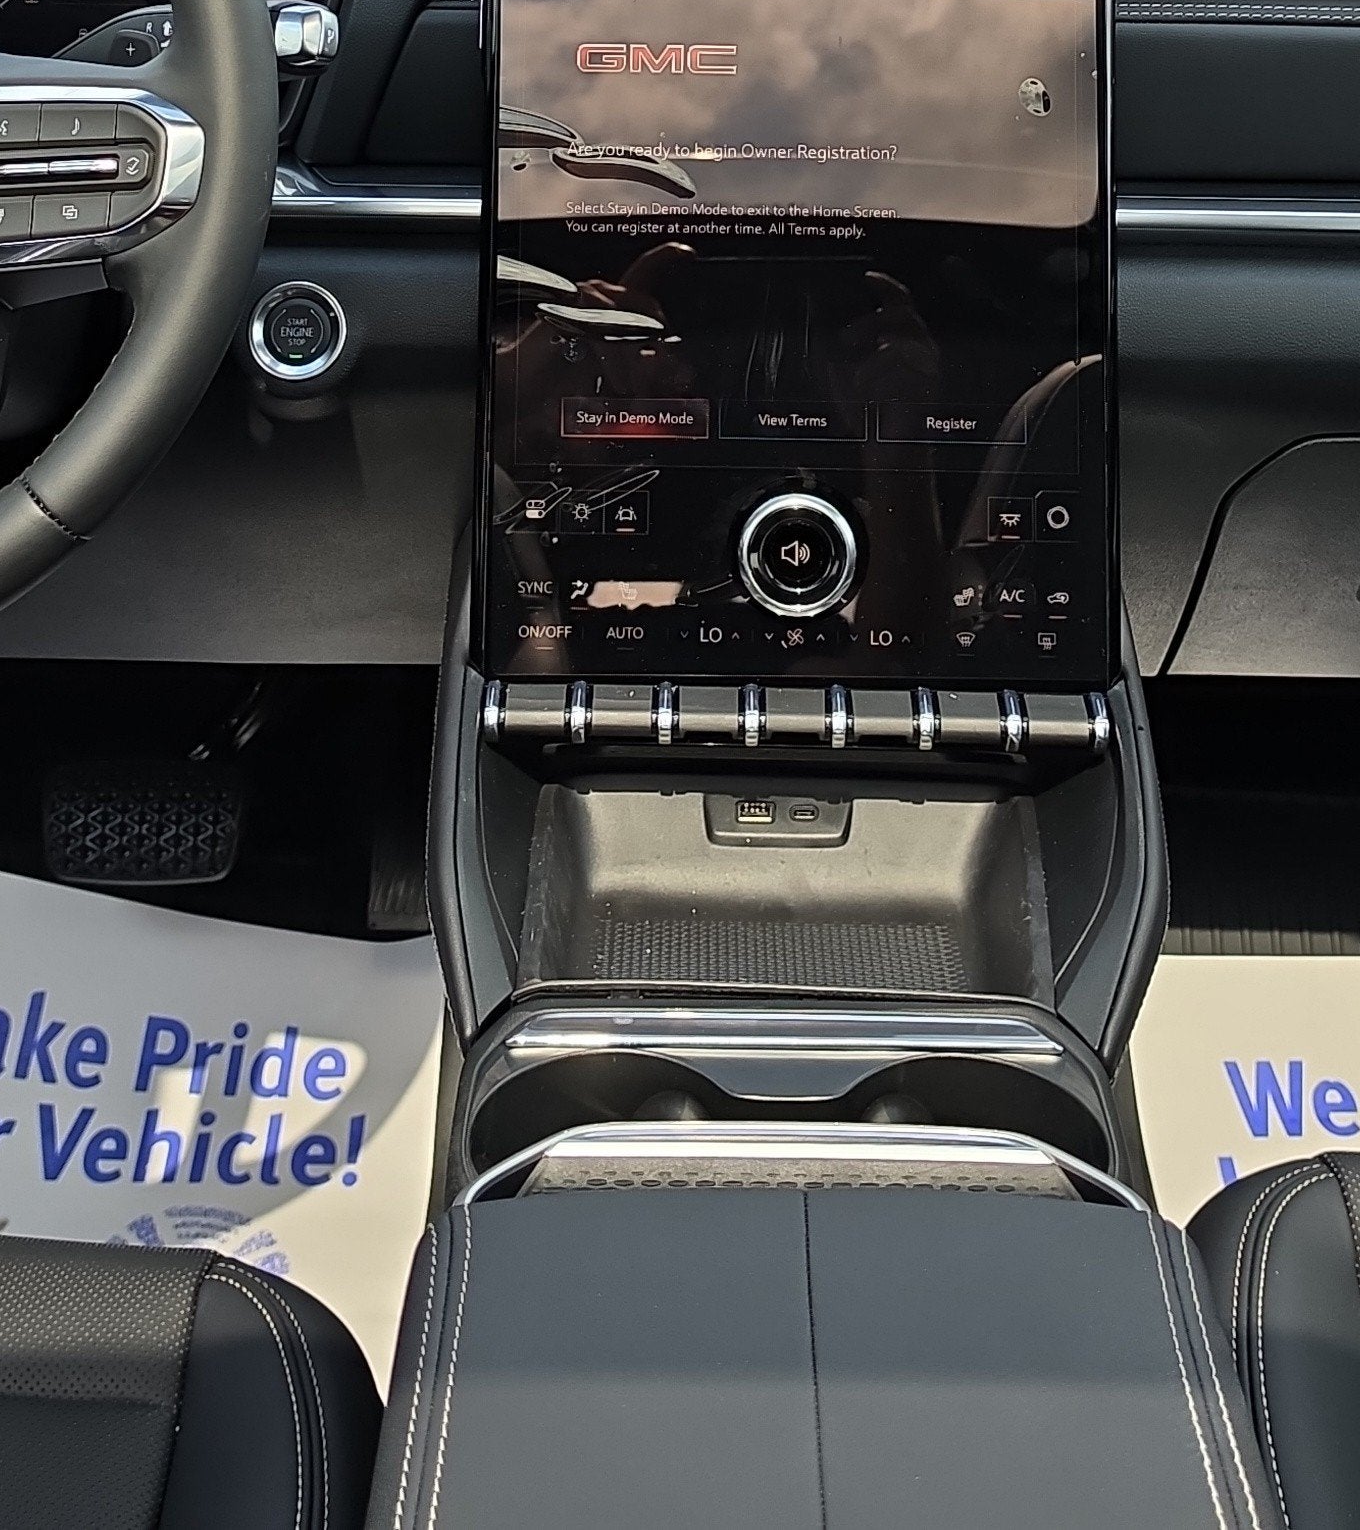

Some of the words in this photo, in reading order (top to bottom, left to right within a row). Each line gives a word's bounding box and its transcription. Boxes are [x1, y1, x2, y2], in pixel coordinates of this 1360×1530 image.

[576, 43, 738, 75] GMC
[567, 144, 592, 156] Are
[597, 146, 624, 159] you
[629, 144, 670, 160] ready
[675, 146, 690, 158] to
[694, 144, 737, 162] begin
[741, 145, 794, 159] Owner
[797, 145, 898, 163] Registration?
[566, 202, 604, 215] Select
[607, 203, 633, 218] Stay
[636, 203, 648, 215] in
[651, 203, 689, 215] Demo
[693, 204, 728, 216] Mode
[731, 206, 744, 216] to
[747, 205, 770, 217] exit
[773, 206, 786, 217] to
[789, 205, 809, 217] the
[813, 206, 851, 218] Home
[853, 206, 901, 218] Screen.
[565, 221, 589, 233] You
[591, 224, 614, 233] can
[617, 222, 664, 237] register
[667, 224, 680, 234] at
[683, 222, 731, 234] another
[734, 223, 766, 235] time.
[768, 223, 785, 235] All
[789, 224, 826, 236] Terms
[829, 224, 866, 239] apply.
[287, 318, 308, 326] START
[280, 327, 314, 338] ENGINE
[576, 411, 603, 425] Stay
[605, 411, 617, 423] in
[620, 412, 656, 424] Demo
[659, 412, 694, 425] Mode
[758, 414, 788, 426] View
[791, 415, 828, 427] Terms
[927, 416, 977, 432] Register
[518, 581, 553, 596] SYNC
[1000, 588, 1026, 604] A/C
[518, 625, 573, 641] ON/OFF
[606, 626, 645, 641] AUTO
[700, 627, 723, 644] LO
[870, 629, 893, 647] LO
[133, 1015, 348, 1103] Pride
[1224, 1059, 1360, 1138] We
[37, 1102, 368, 1190] Vehicle!
